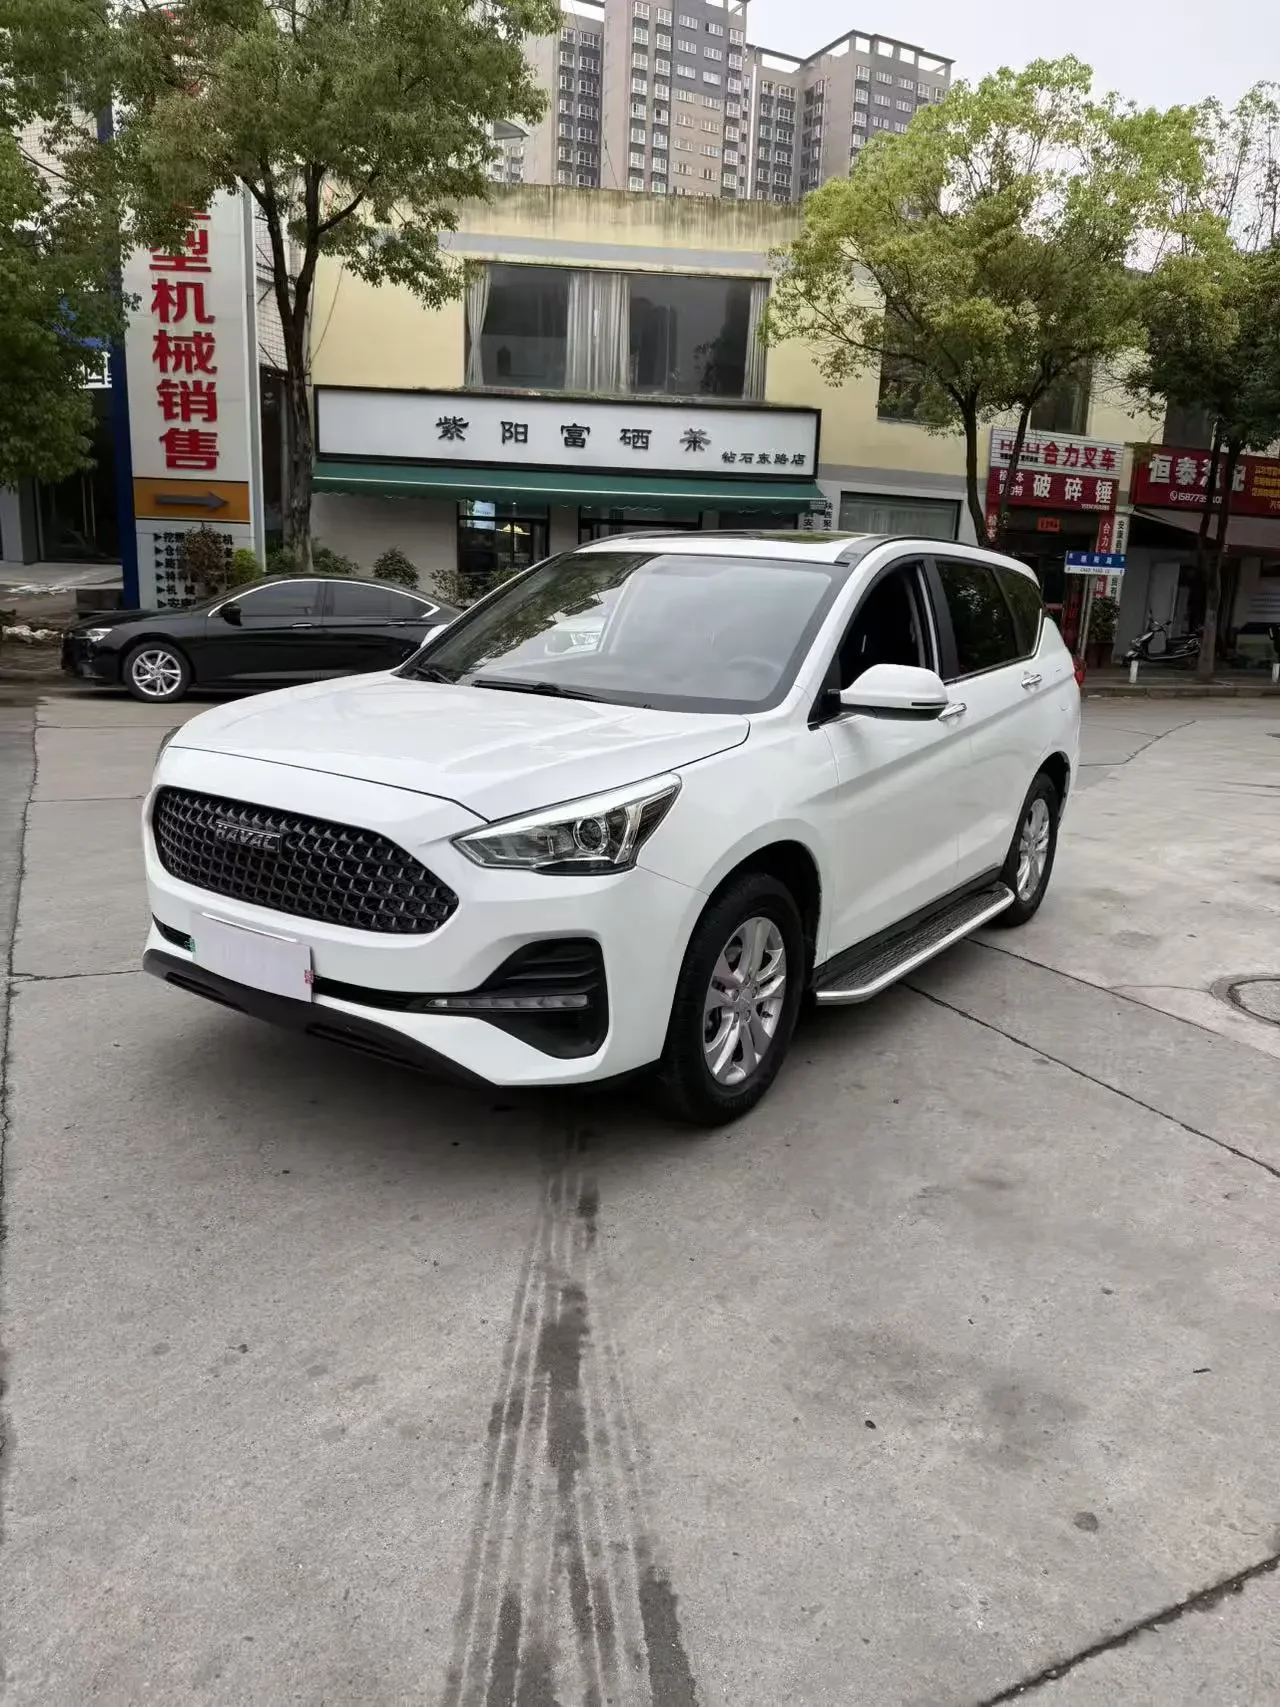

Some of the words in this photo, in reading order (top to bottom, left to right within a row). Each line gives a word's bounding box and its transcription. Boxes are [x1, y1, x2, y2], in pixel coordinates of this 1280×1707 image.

[149, 205, 219, 470] 型机械销售
[435, 416, 711, 452] 紫阳富硒茶
[721, 452, 806, 465] 钻石东路店
[1043, 441, 1117, 471] 合力叉车
[1033, 473, 1113, 504] 破碎锤
